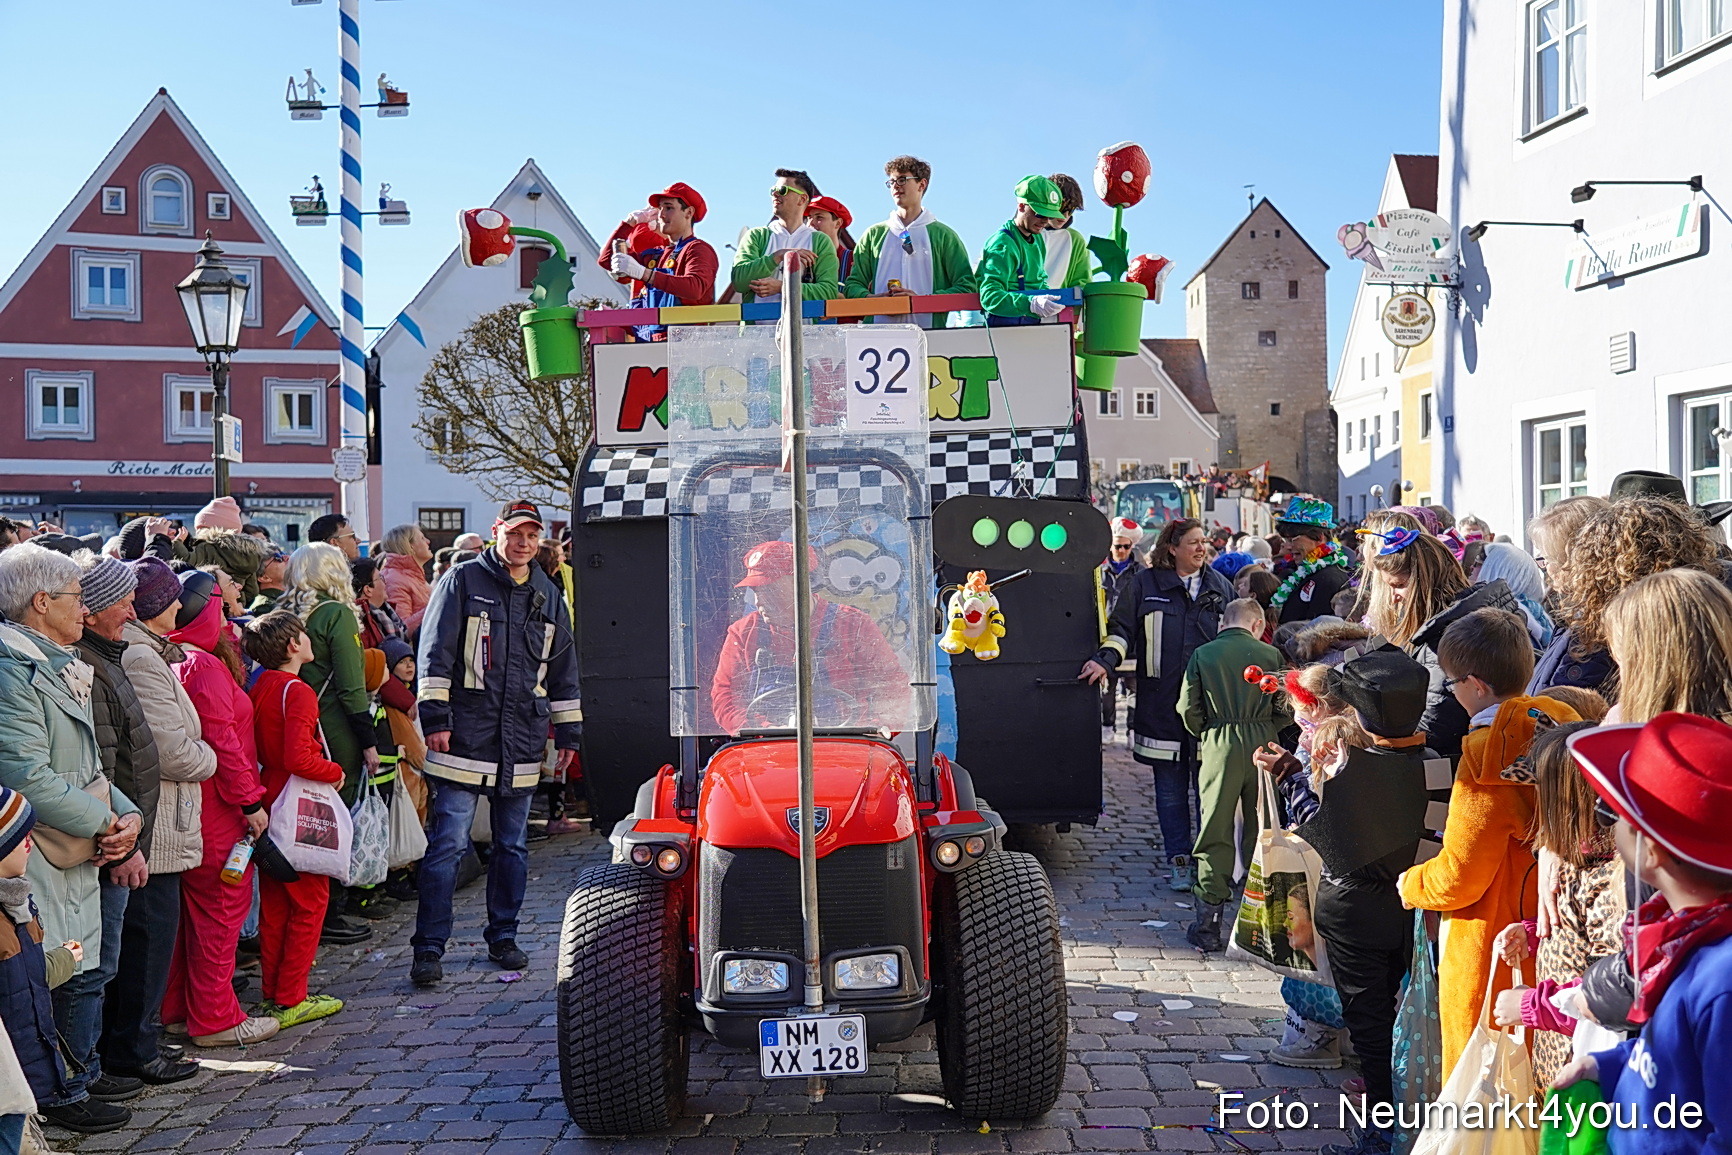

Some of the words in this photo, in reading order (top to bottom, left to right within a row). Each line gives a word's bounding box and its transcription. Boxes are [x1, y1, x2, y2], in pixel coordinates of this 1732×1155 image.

[1386, 212, 1431, 224] Pizzeria
[1397, 228, 1421, 239] Café
[1384, 241, 1432, 255] Eisdiele
[1586, 250, 1622, 277] Bella
[1628, 240, 1672, 265] Roma
[1392, 264, 1425, 273] Bella
[1370, 271, 1405, 280] Roma
[855, 347, 911, 394] 32
[107, 461, 161, 475] Riebe
[164, 463, 215, 476] Mode
[298, 815, 330, 826] INTEGRATED
[298, 820, 327, 832] SOLUTIONS
[767, 1037, 774, 1045] D
[786, 1022, 819, 1046] NM
[770, 1049, 803, 1074] XX
[812, 1046, 860, 1072] 128
